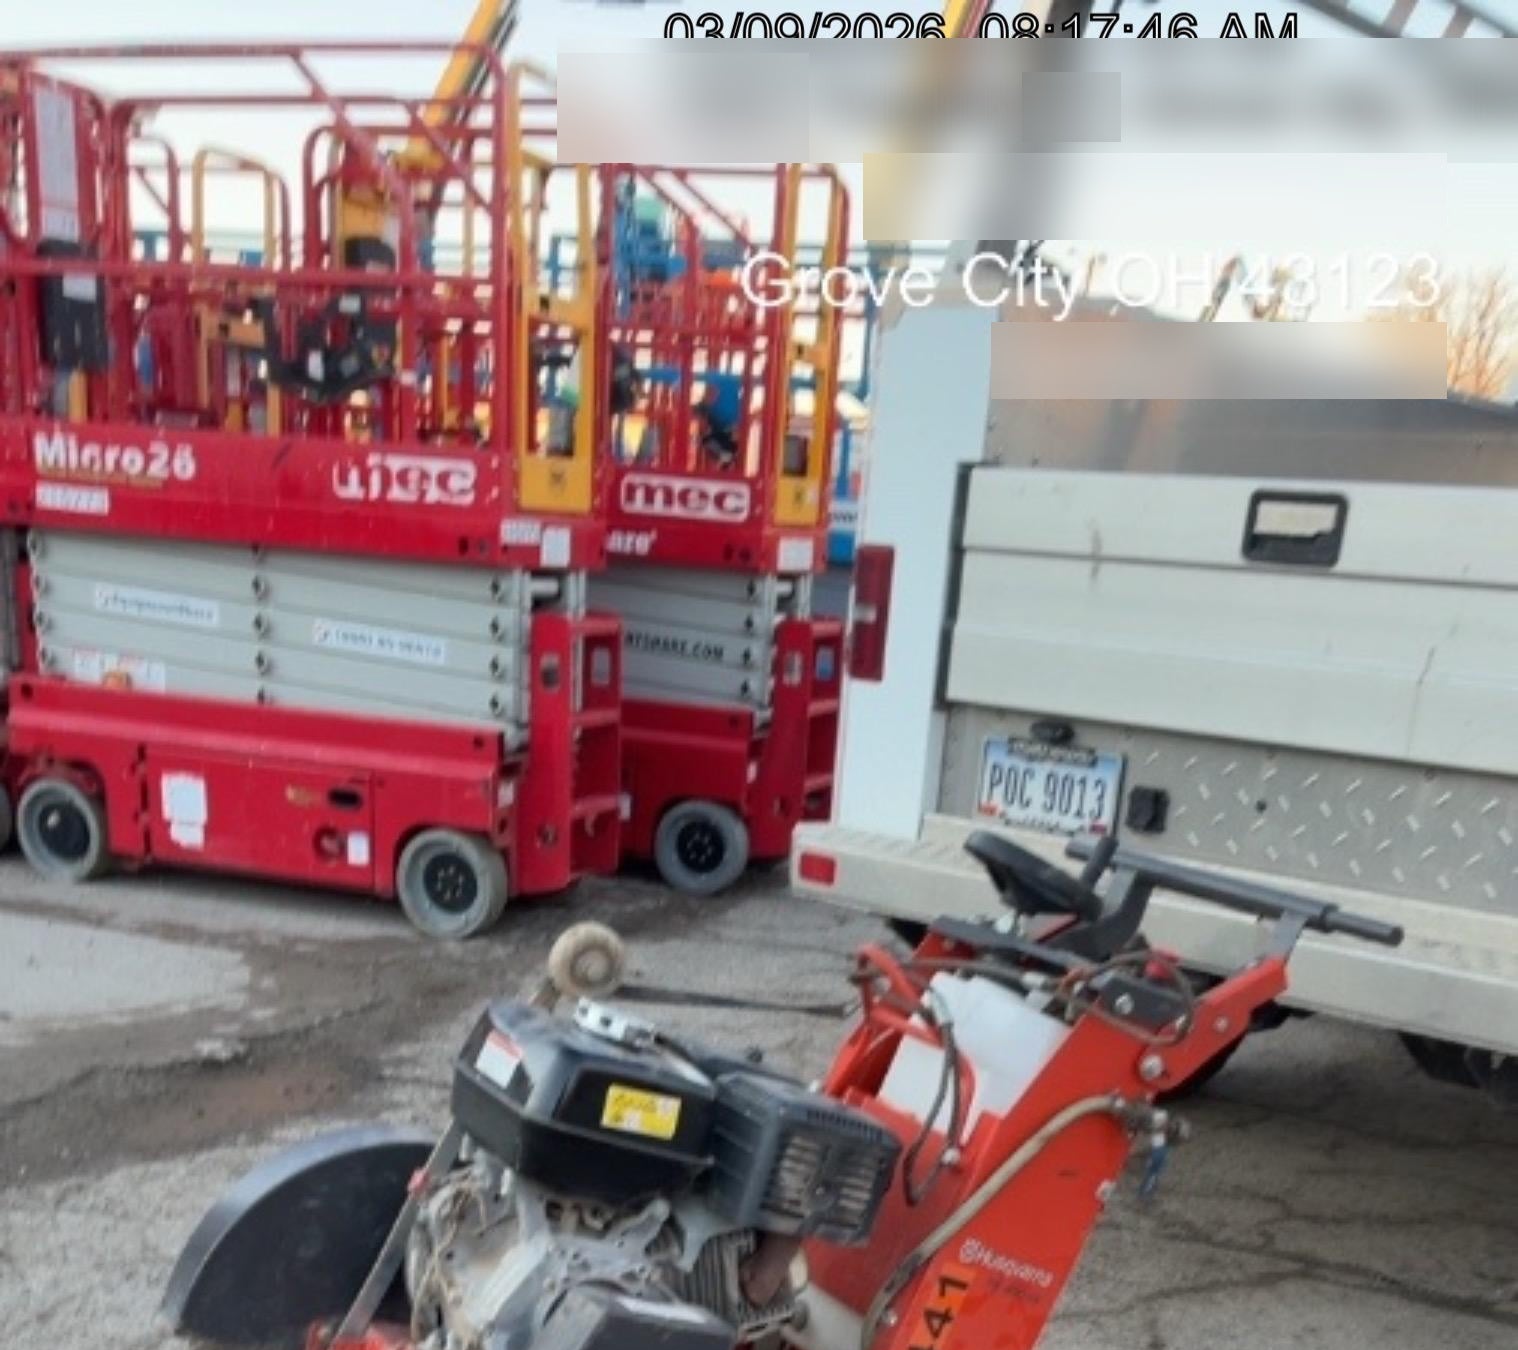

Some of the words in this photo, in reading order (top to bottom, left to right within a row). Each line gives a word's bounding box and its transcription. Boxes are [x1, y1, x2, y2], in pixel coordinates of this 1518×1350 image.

[623, 479, 747, 515] mec
[1043, 768, 1108, 820] 9013
[980, 1245, 1054, 1288] Husqvarna
